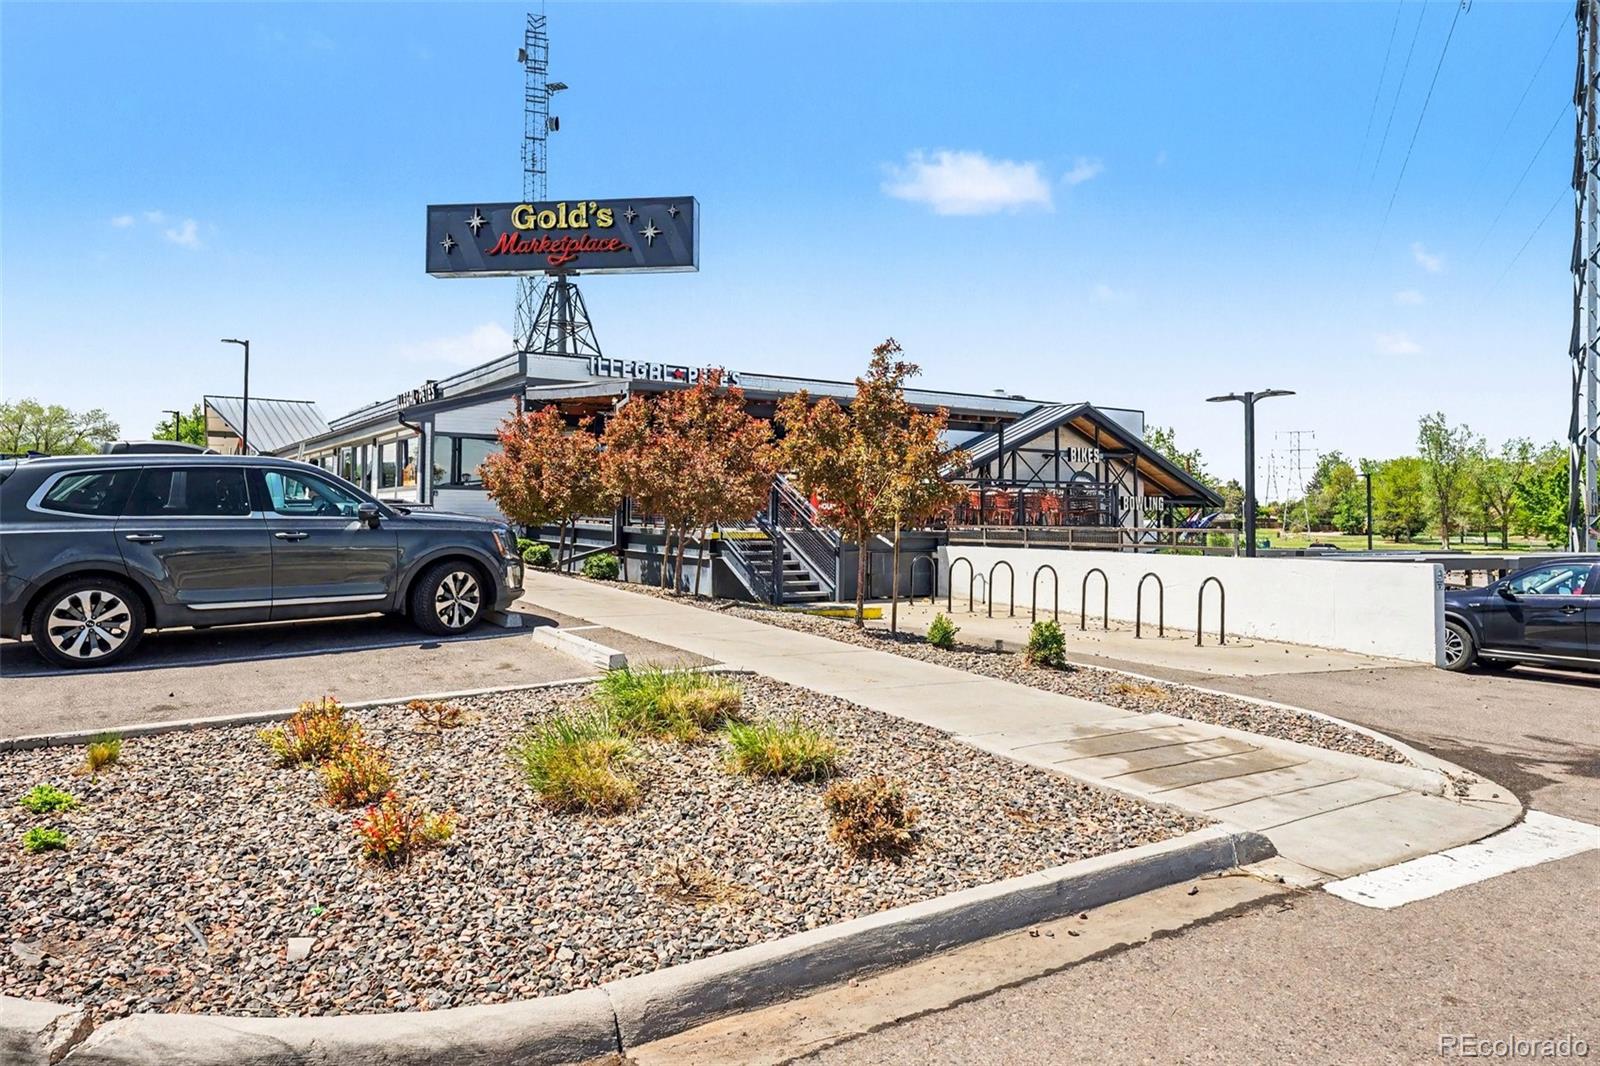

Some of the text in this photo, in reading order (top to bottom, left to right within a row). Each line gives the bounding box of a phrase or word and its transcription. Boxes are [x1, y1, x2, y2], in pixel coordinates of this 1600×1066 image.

[511, 202, 614, 230] Gold's
[485, 231, 632, 265] Marketplace
[589, 356, 741, 387] ILLEGAL PE'S
[1069, 446, 1100, 464] BIKES
[1122, 495, 1165, 512] BOWLING
